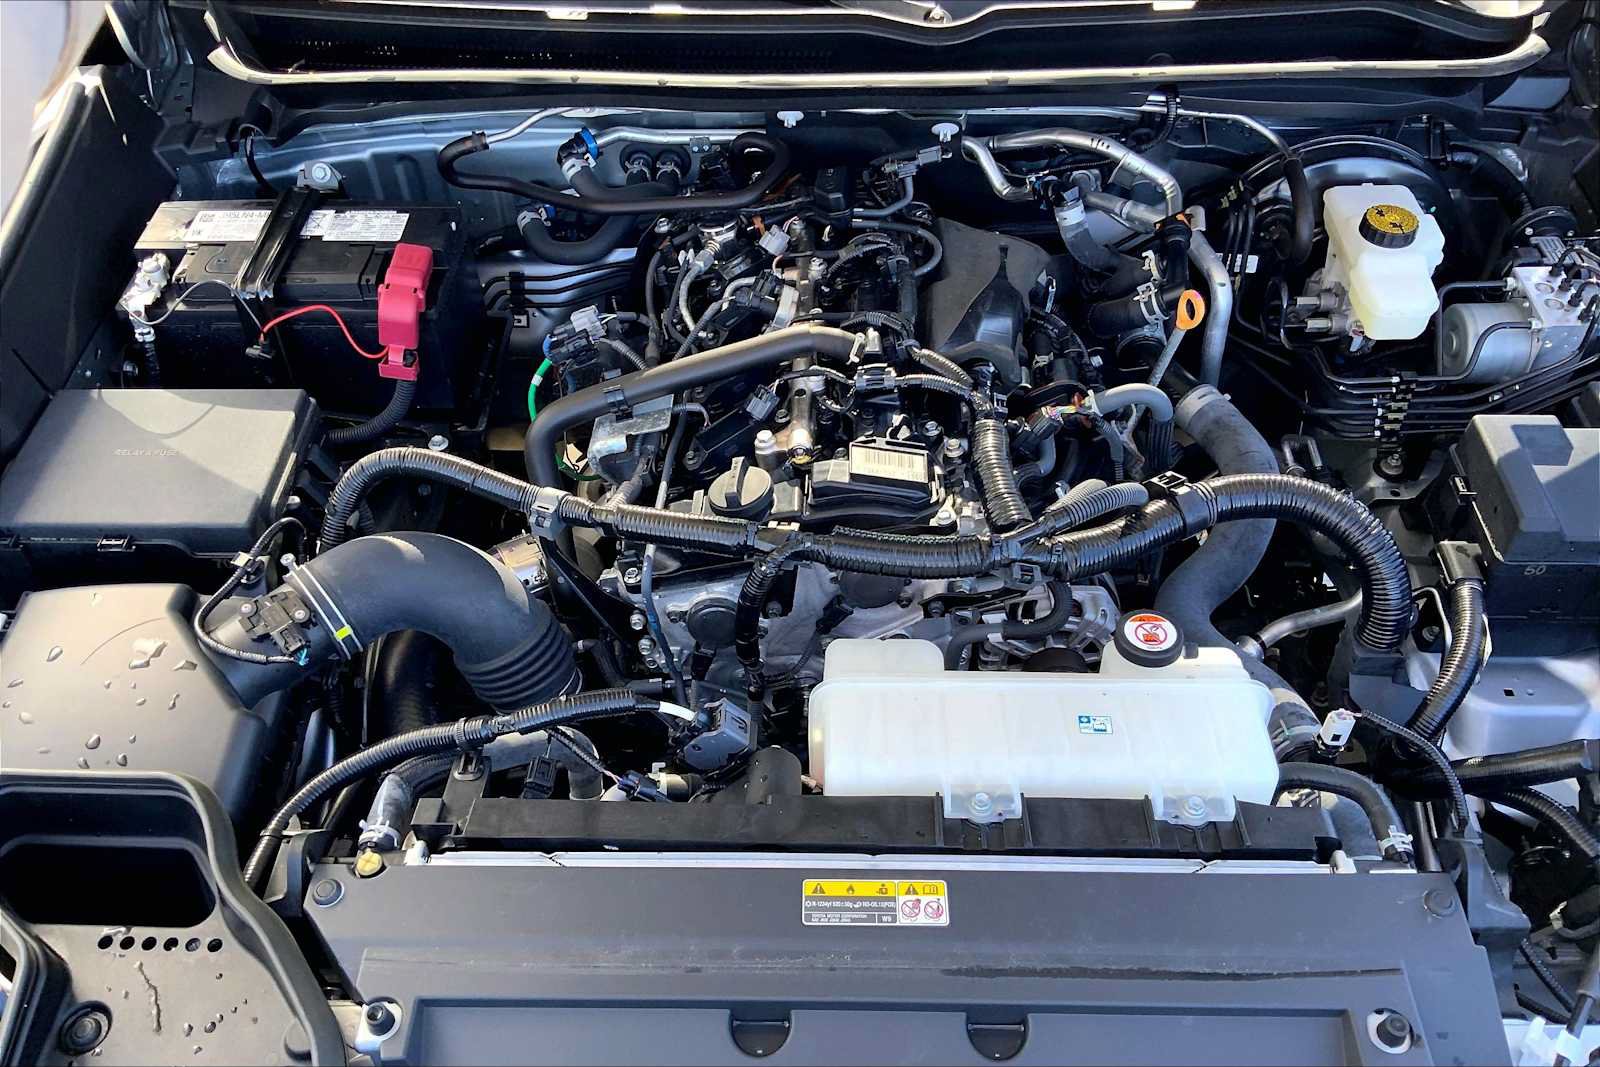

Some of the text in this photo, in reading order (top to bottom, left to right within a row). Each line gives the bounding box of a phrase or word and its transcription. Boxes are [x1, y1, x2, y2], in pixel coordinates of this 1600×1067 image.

[113, 448, 144, 457] RELAY
[154, 448, 178, 457] FUSE
[1524, 565, 1546, 575] 50
